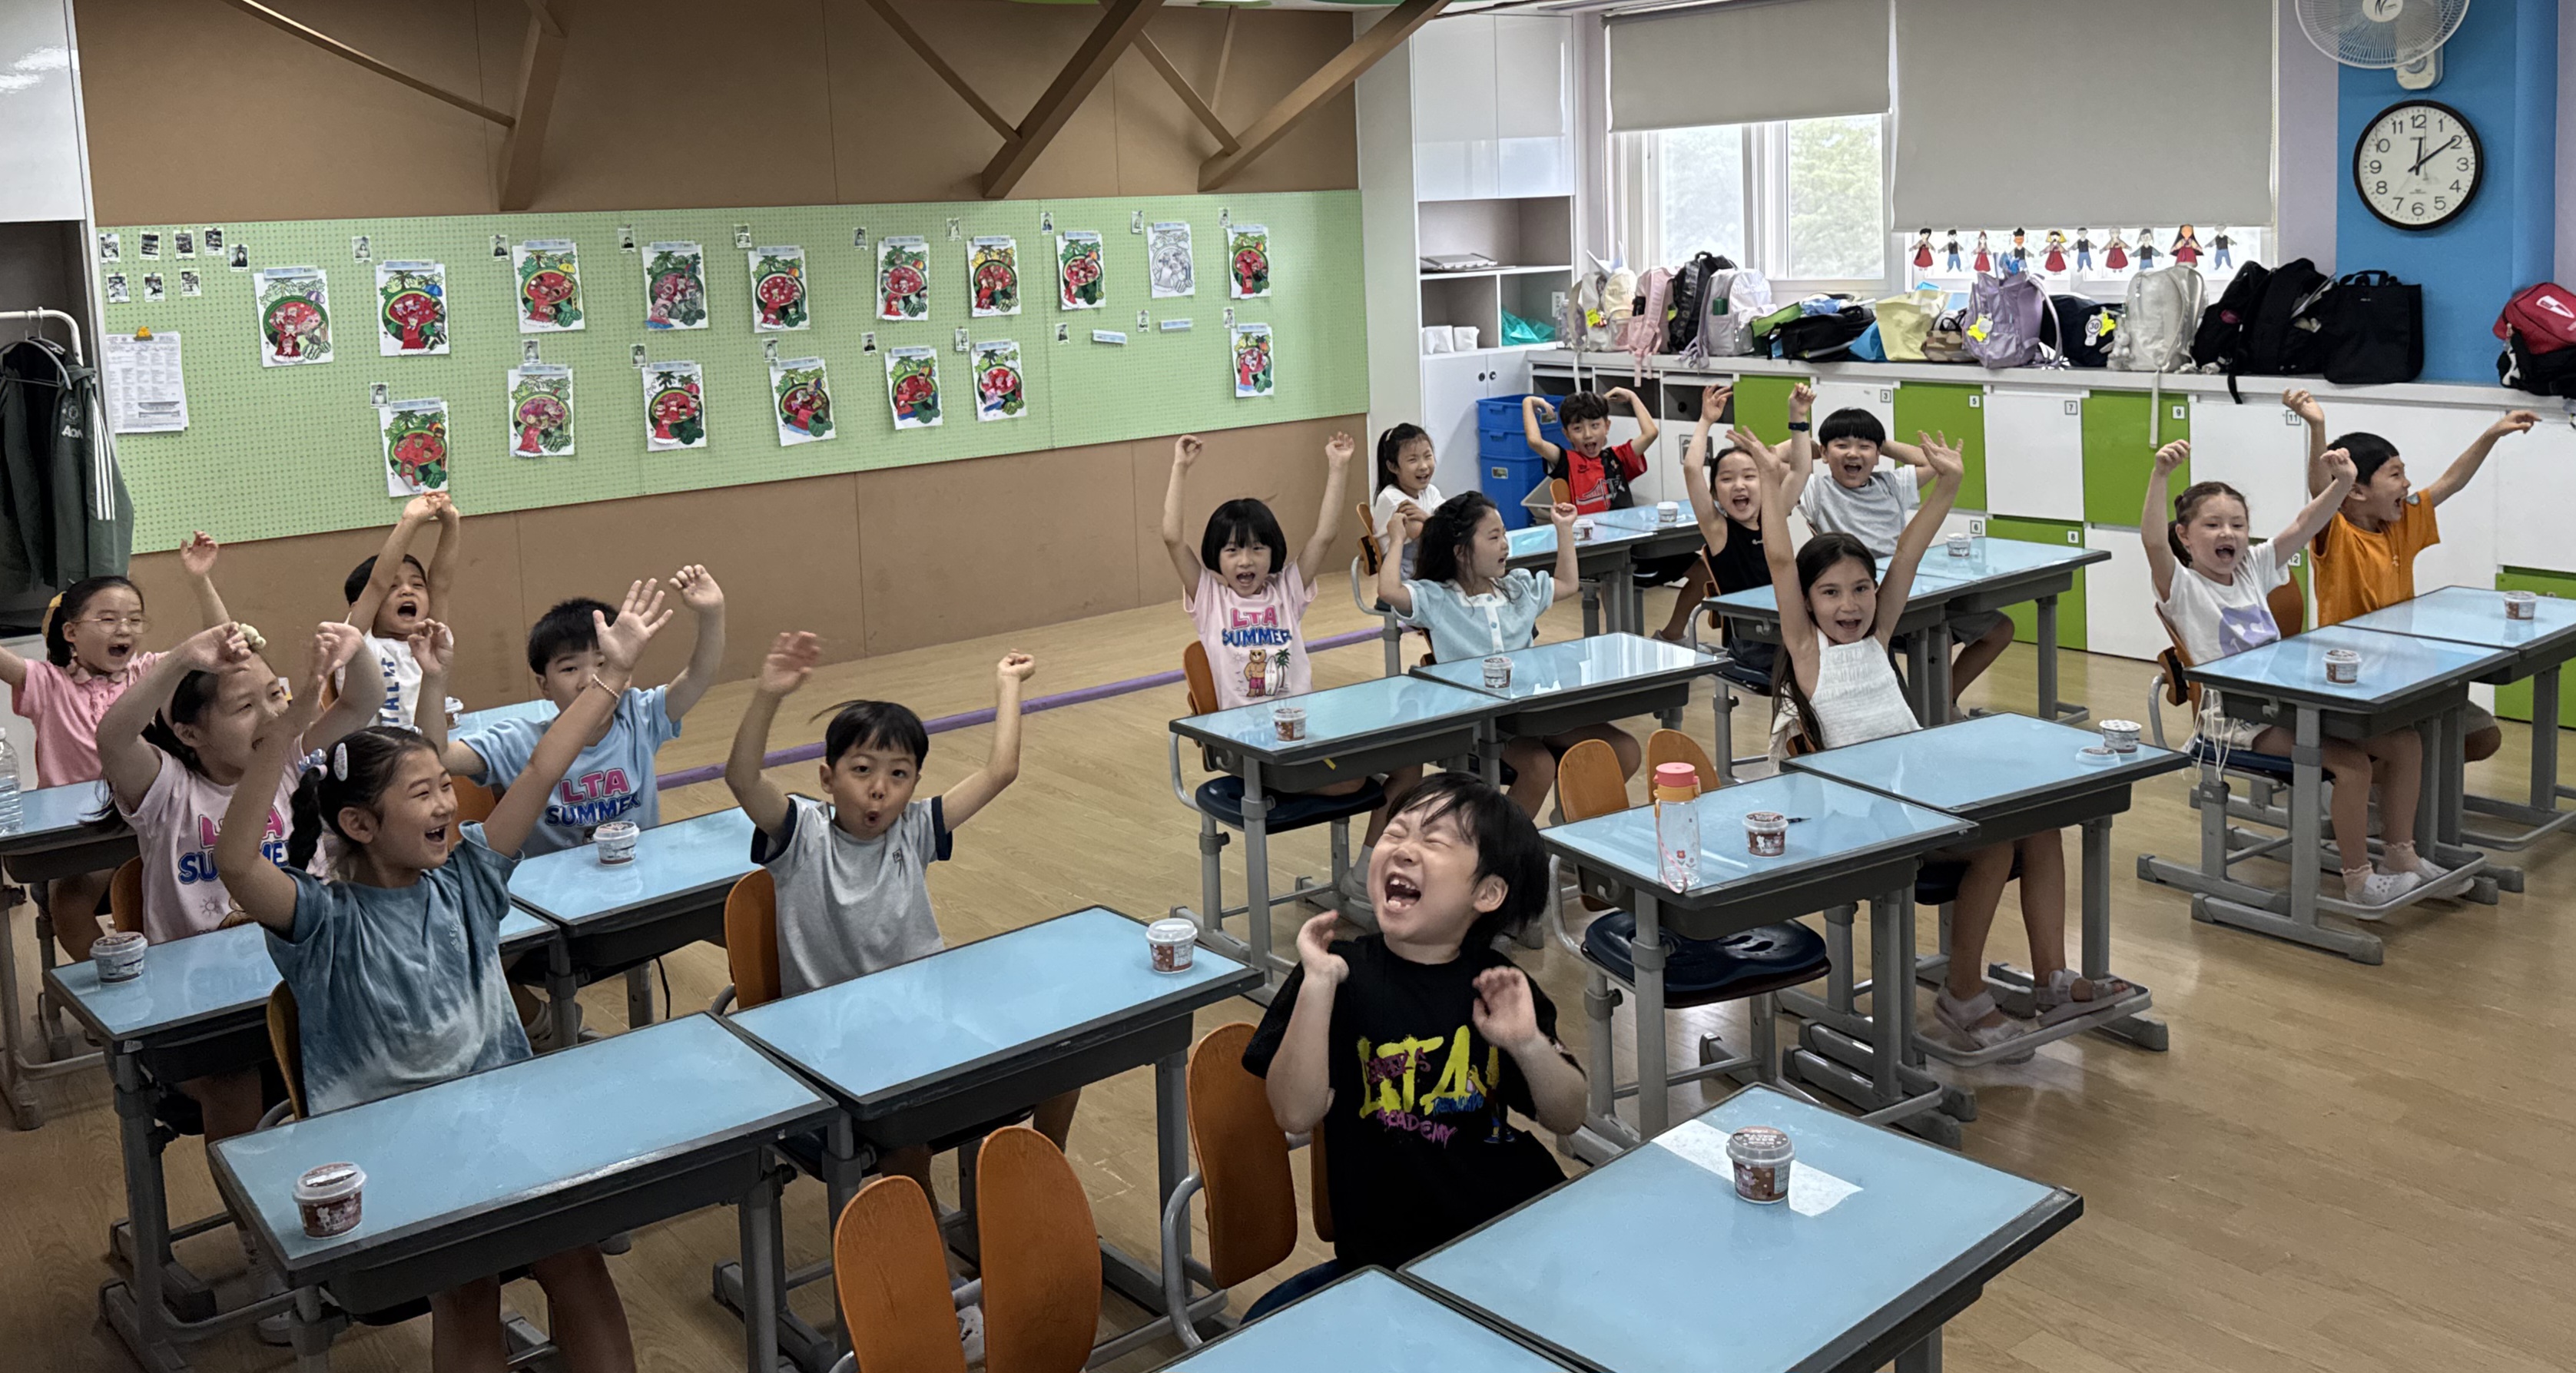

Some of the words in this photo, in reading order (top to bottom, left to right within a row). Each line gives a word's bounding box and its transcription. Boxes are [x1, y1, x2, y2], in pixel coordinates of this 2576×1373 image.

[2392, 121, 2403, 134] 11
[2411, 114, 2426, 128] 12
[2438, 118, 2443, 132] 1
[2375, 138, 2390, 153] 10
[2450, 135, 2462, 149] 2
[2369, 160, 2382, 174] 9
[2456, 158, 2469, 171] 3
[2376, 181, 2387, 194] 8
[2449, 179, 2462, 193] 4
[2392, 197, 2404, 211] 7
[2412, 202, 2424, 216] 6
[2434, 196, 2446, 211] 5
[1231, 605, 1278, 629] LTA
[1222, 627, 1293, 648] SUMMER
[559, 768, 631, 805] LTA
[198, 805, 285, 849] LA
[178, 837, 290, 885] SUE
[1357, 1025, 1474, 1119] LTA
[1376, 1106, 1458, 1149] ACADEMY
